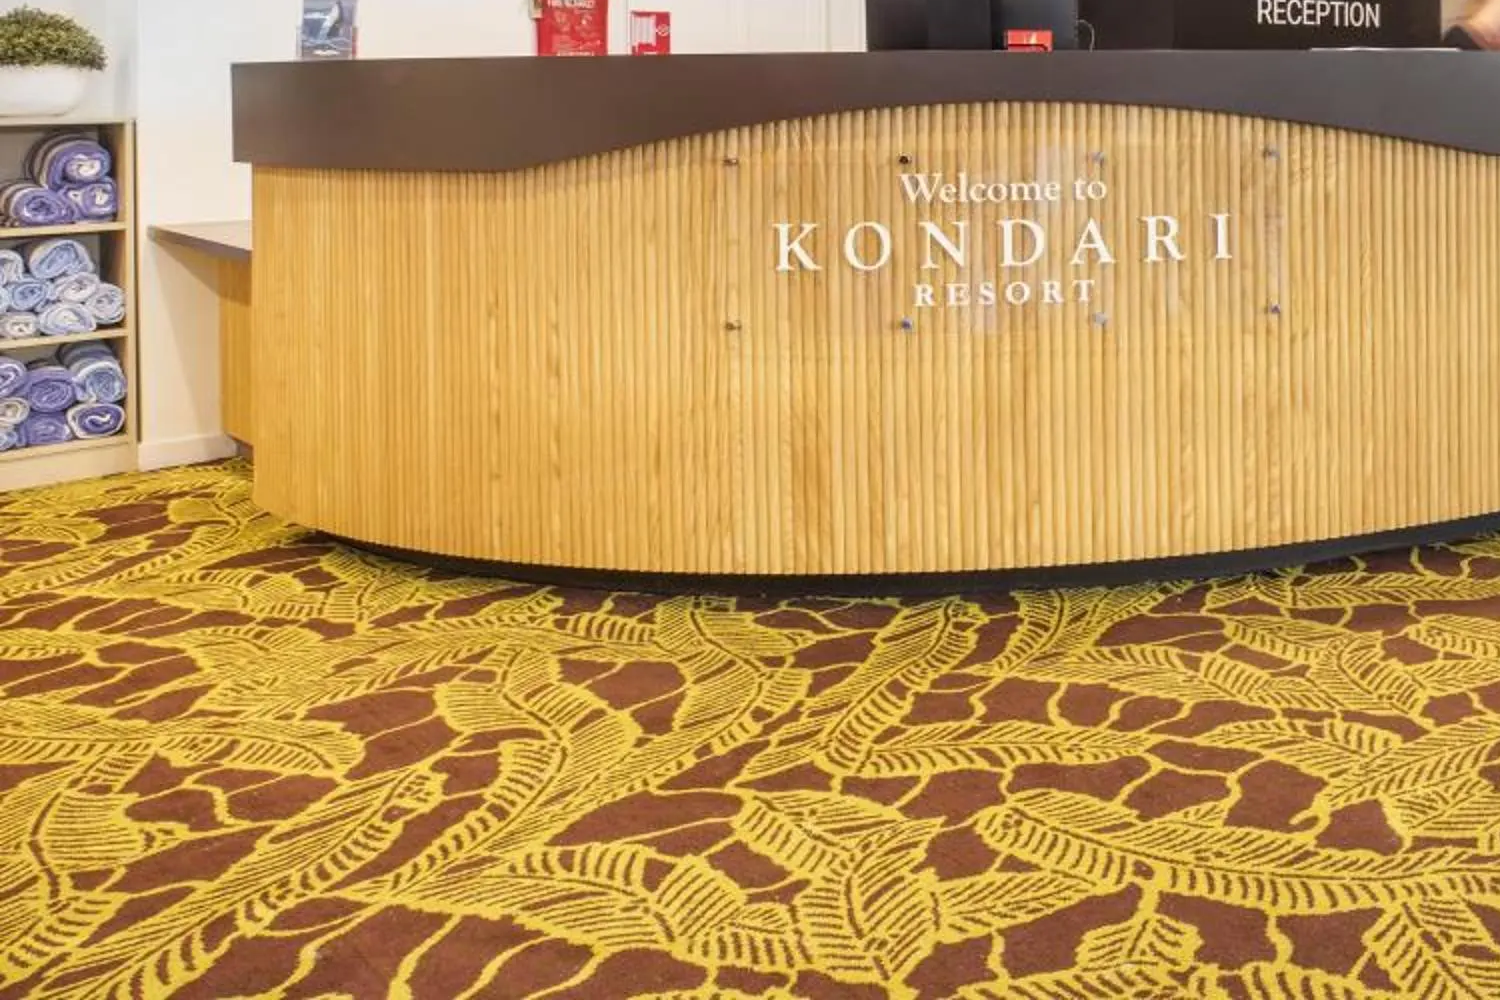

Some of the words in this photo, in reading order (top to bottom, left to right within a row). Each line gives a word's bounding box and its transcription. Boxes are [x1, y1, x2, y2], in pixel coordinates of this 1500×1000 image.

[899, 172, 1061, 202] Welcome
[1073, 174, 1107, 201] to
[773, 213, 1233, 271] KONDARI
[915, 279, 1095, 307] RESORT
